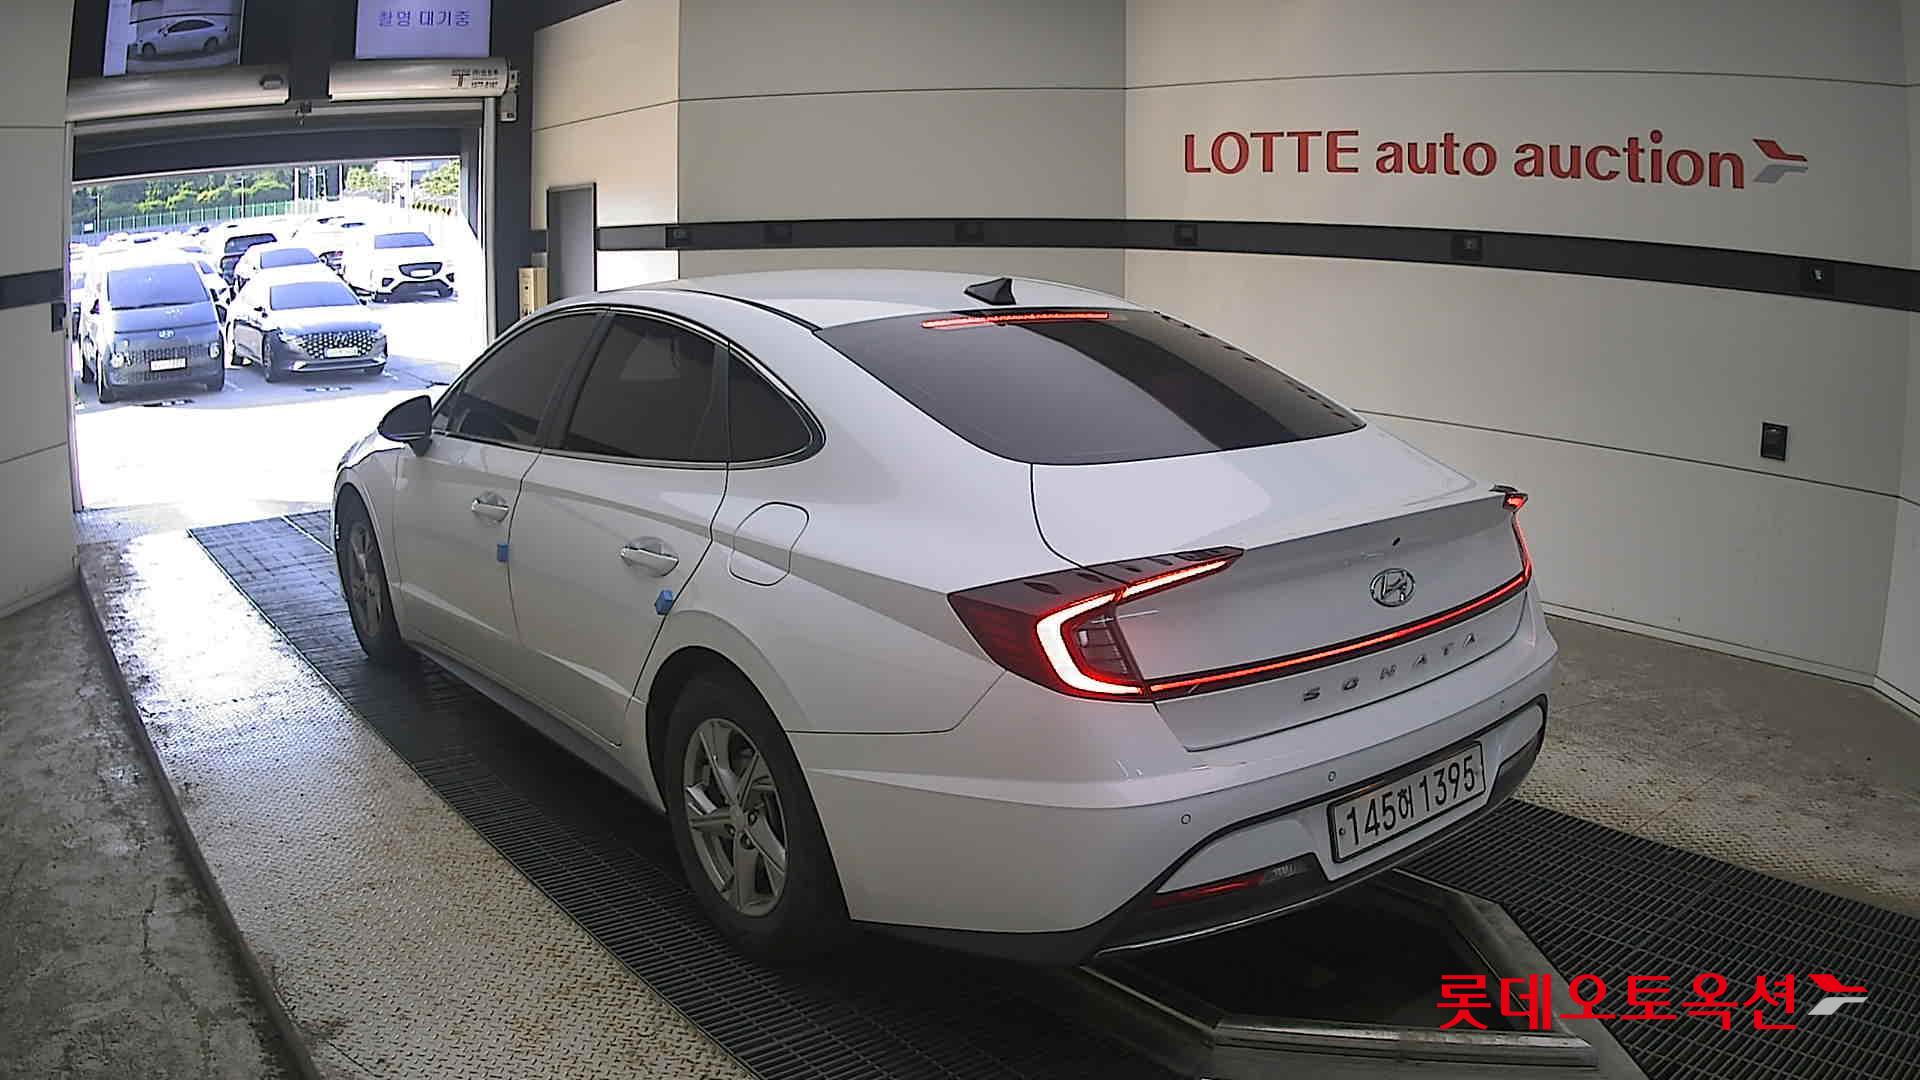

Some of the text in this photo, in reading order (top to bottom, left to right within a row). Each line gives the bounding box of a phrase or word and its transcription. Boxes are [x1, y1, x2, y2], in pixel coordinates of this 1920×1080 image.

[1184, 129, 1744, 189] LOTTE auto auction
[1302, 632, 1477, 701] SONATA
